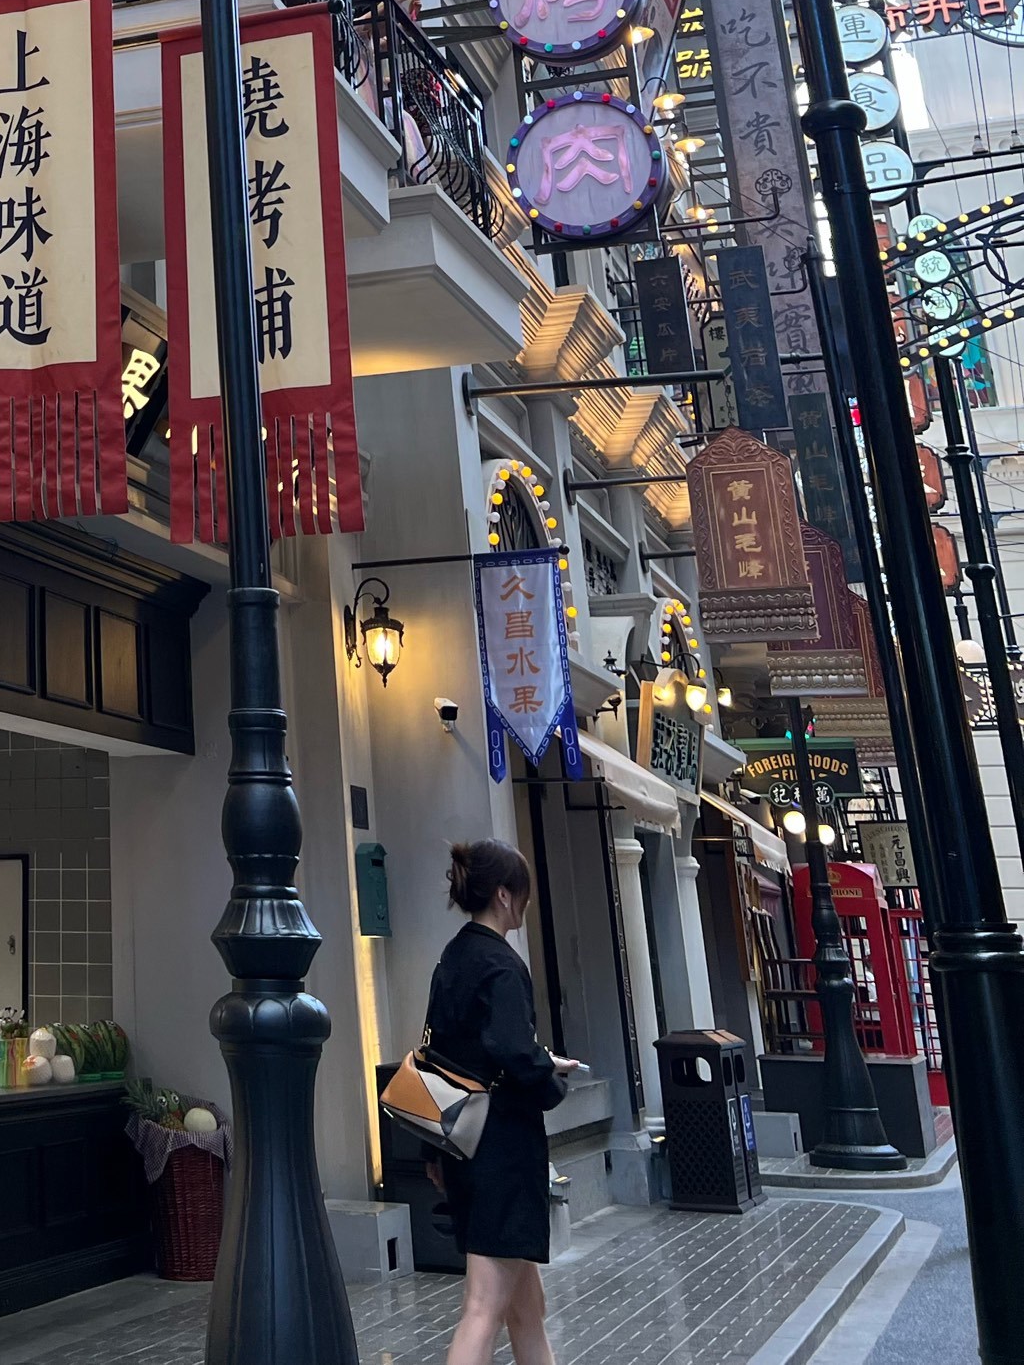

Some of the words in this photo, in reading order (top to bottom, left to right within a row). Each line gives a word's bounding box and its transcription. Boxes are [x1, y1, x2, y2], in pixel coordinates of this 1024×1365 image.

[500, 574, 544, 714] 久昌水果
[747, 753, 795, 778] FOREIG
[831, 888, 861, 896] PHONE
